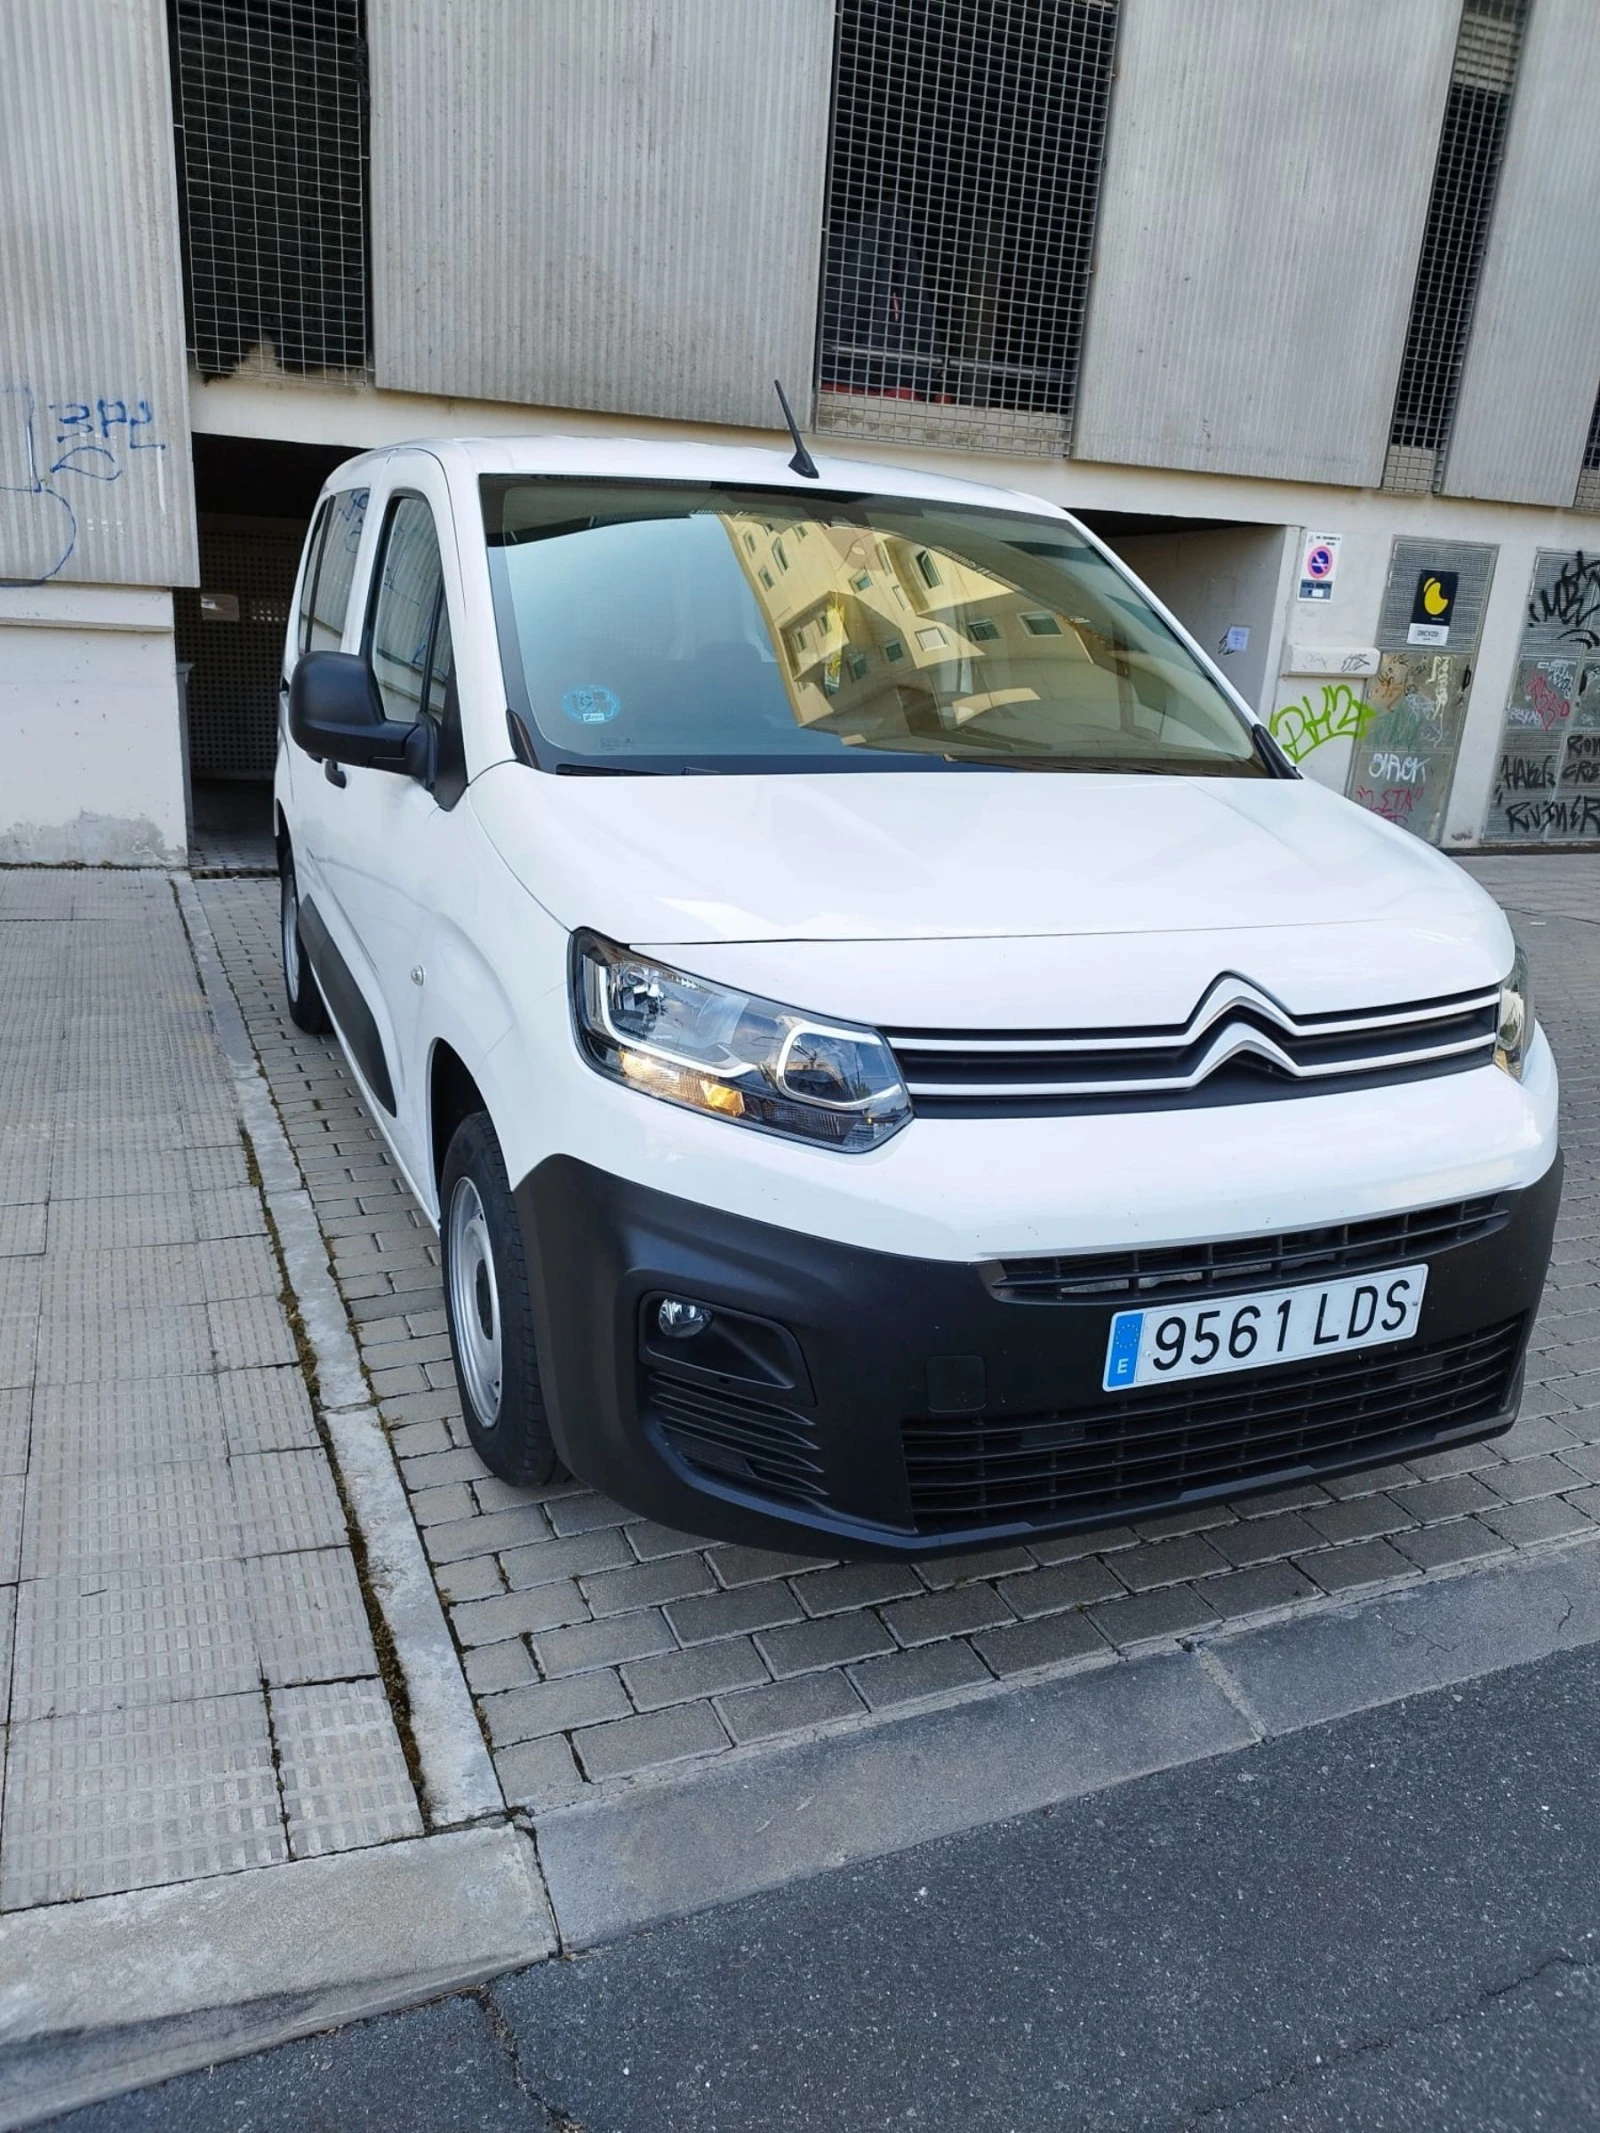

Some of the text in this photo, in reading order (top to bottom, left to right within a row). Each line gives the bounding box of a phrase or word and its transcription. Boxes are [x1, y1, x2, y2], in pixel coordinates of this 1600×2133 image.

[1116, 1279, 1411, 1374] E 9561 LDS
